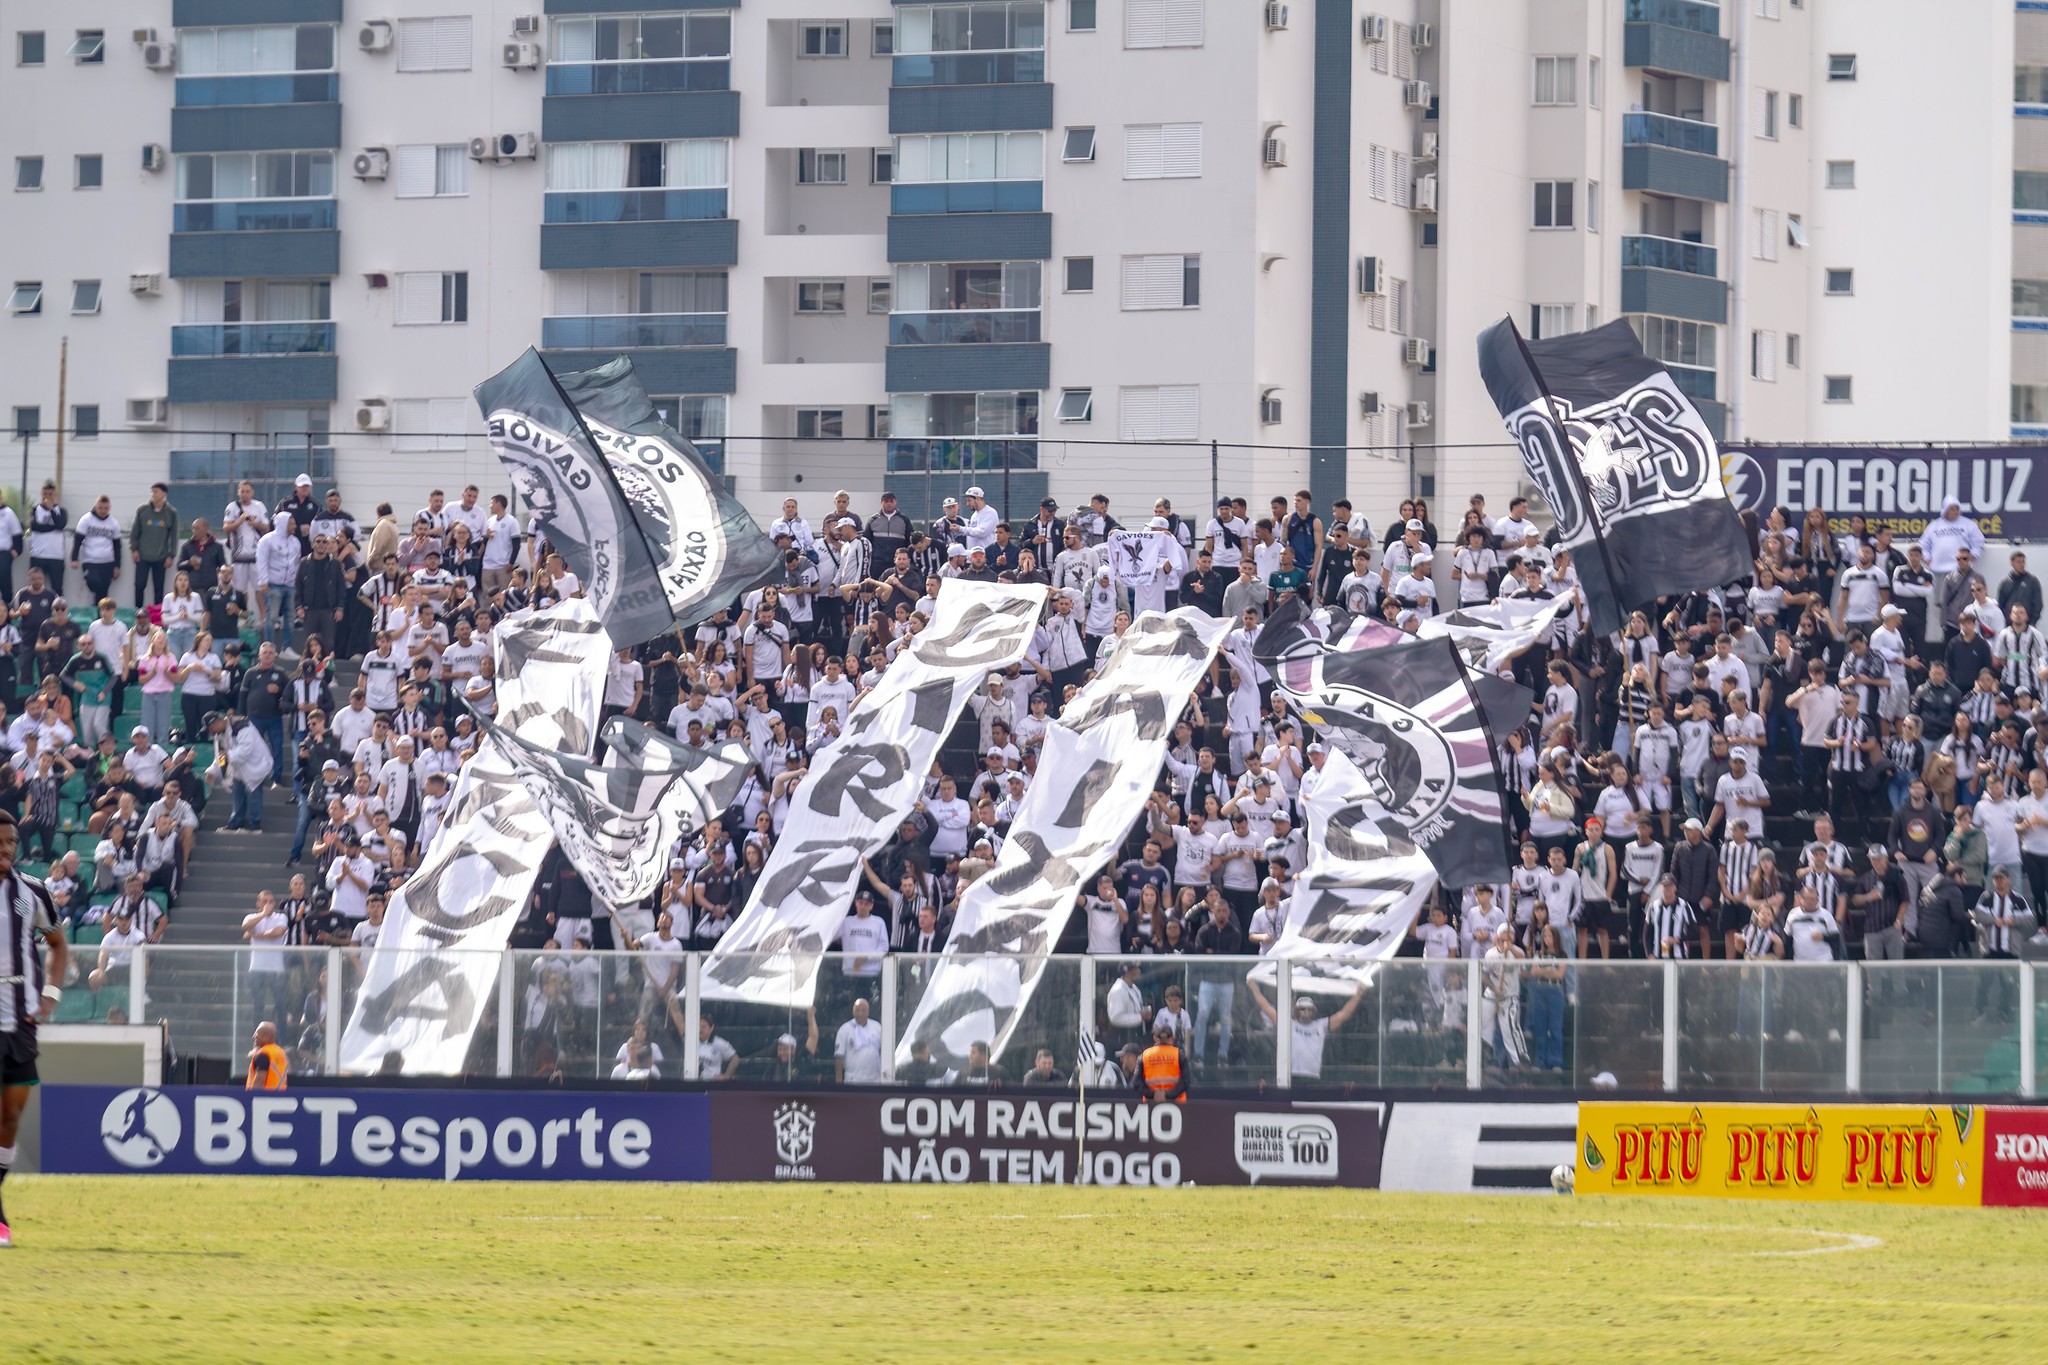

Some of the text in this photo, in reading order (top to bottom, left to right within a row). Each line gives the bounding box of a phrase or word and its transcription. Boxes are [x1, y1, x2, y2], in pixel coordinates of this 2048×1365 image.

[1776, 457, 2033, 514] ENERGILUZ
[880, 1098, 1183, 1143] COM RACISMO
[1242, 1125, 1284, 1139] DISQUE
[194, 1096, 653, 1182] BETesporte
[1242, 1139, 1284, 1151] DIREITOS
[1612, 1105, 1942, 1190] PITÚ PITÚ PITÚ
[882, 1139, 1182, 1187] NÃO TEM JOGO
[1242, 1151, 1285, 1163] HUMANOS
[1288, 1140, 1330, 1164] 100
[775, 1164, 816, 1180] BRASIL
[2017, 1165, 2048, 1190] Cons
